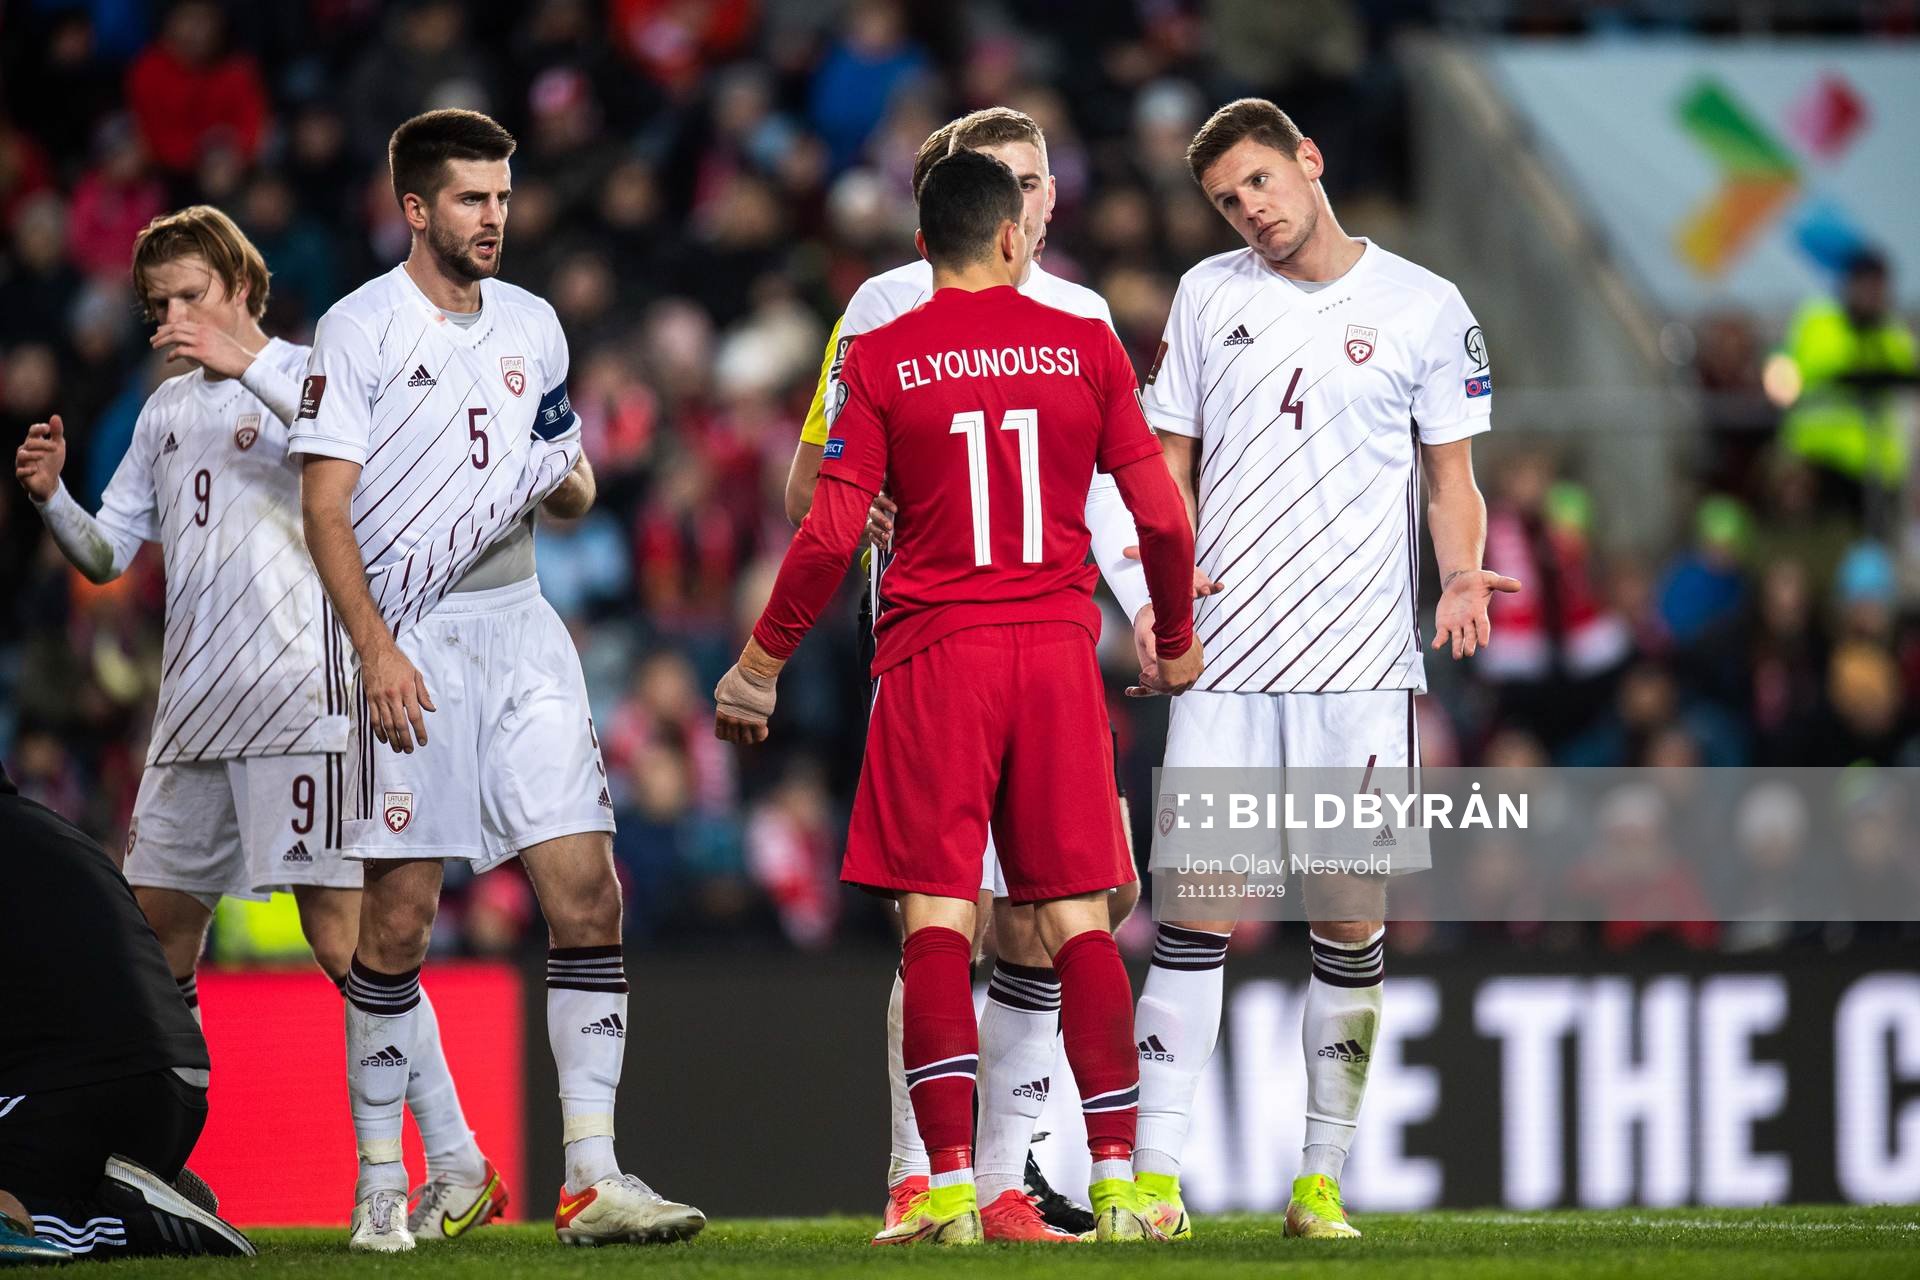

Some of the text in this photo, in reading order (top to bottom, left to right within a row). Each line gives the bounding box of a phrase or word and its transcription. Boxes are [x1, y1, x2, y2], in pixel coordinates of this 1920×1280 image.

[897, 346, 1080, 391] ELYOUNOUSSI
[1280, 368, 1303, 430] 4
[468, 408, 489, 470] 5
[195, 469, 211, 528] 9
[949, 408, 1043, 567] 11
[291, 774, 315, 834] 9
[581, 1026, 626, 1038] adida
[1317, 1049, 1370, 1062] adidas
[360, 1058, 408, 1067] adidas
[1475, 974, 1791, 1210] THE
